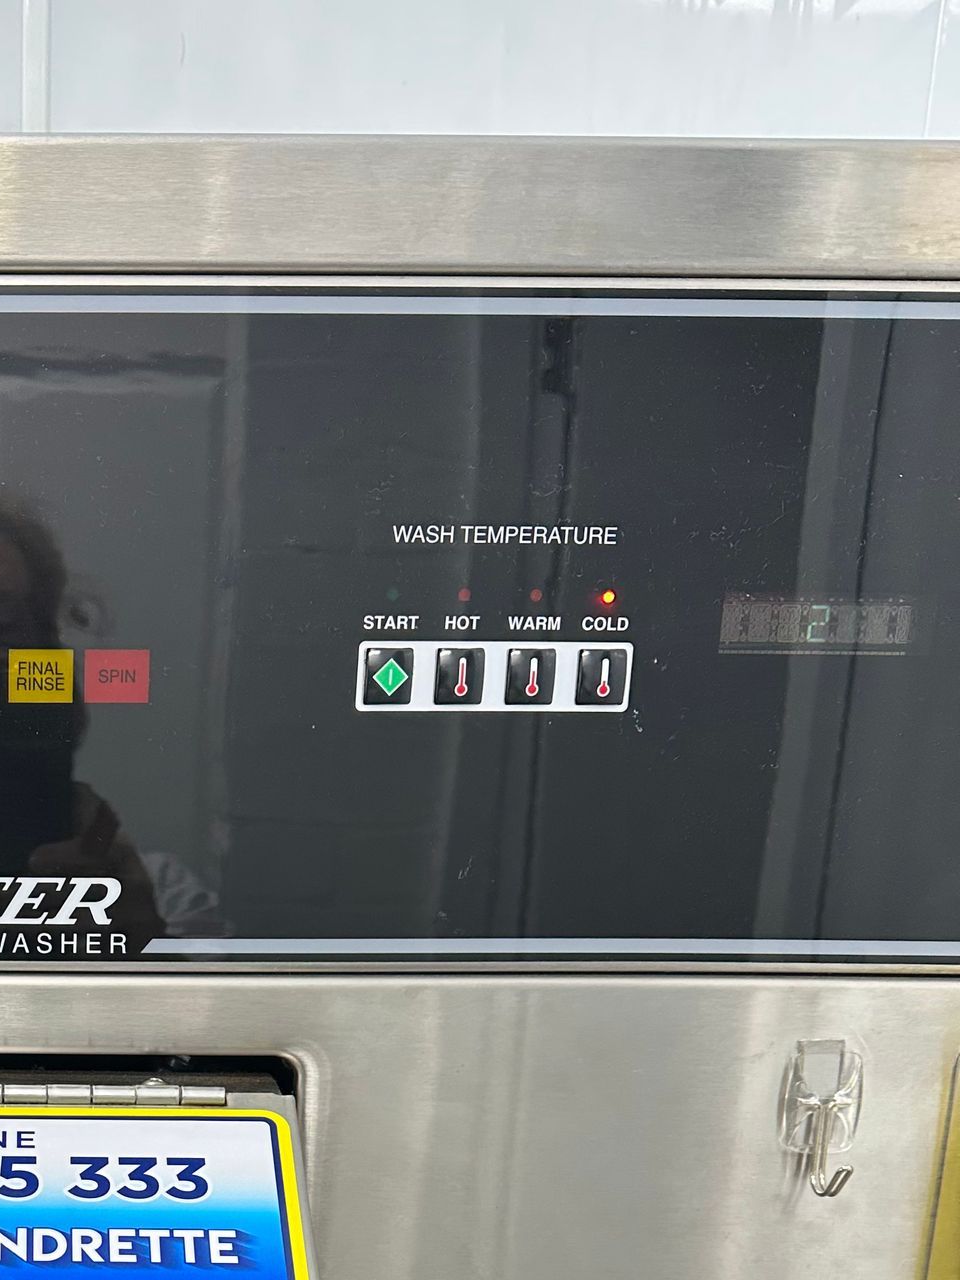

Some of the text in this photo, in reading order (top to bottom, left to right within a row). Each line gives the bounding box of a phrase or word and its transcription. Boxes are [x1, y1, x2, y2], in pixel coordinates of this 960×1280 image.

[393, 525, 618, 546] WASH TEMPERATURE
[363, 616, 418, 630] START
[444, 616, 480, 630] HOT
[508, 616, 561, 631] WARM
[581, 617, 629, 632] COLD
[18, 662, 63, 675] FINAL
[98, 669, 136, 683] SPIN
[16, 677, 65, 691] RINSE
[67, 1157, 209, 1200] 333
